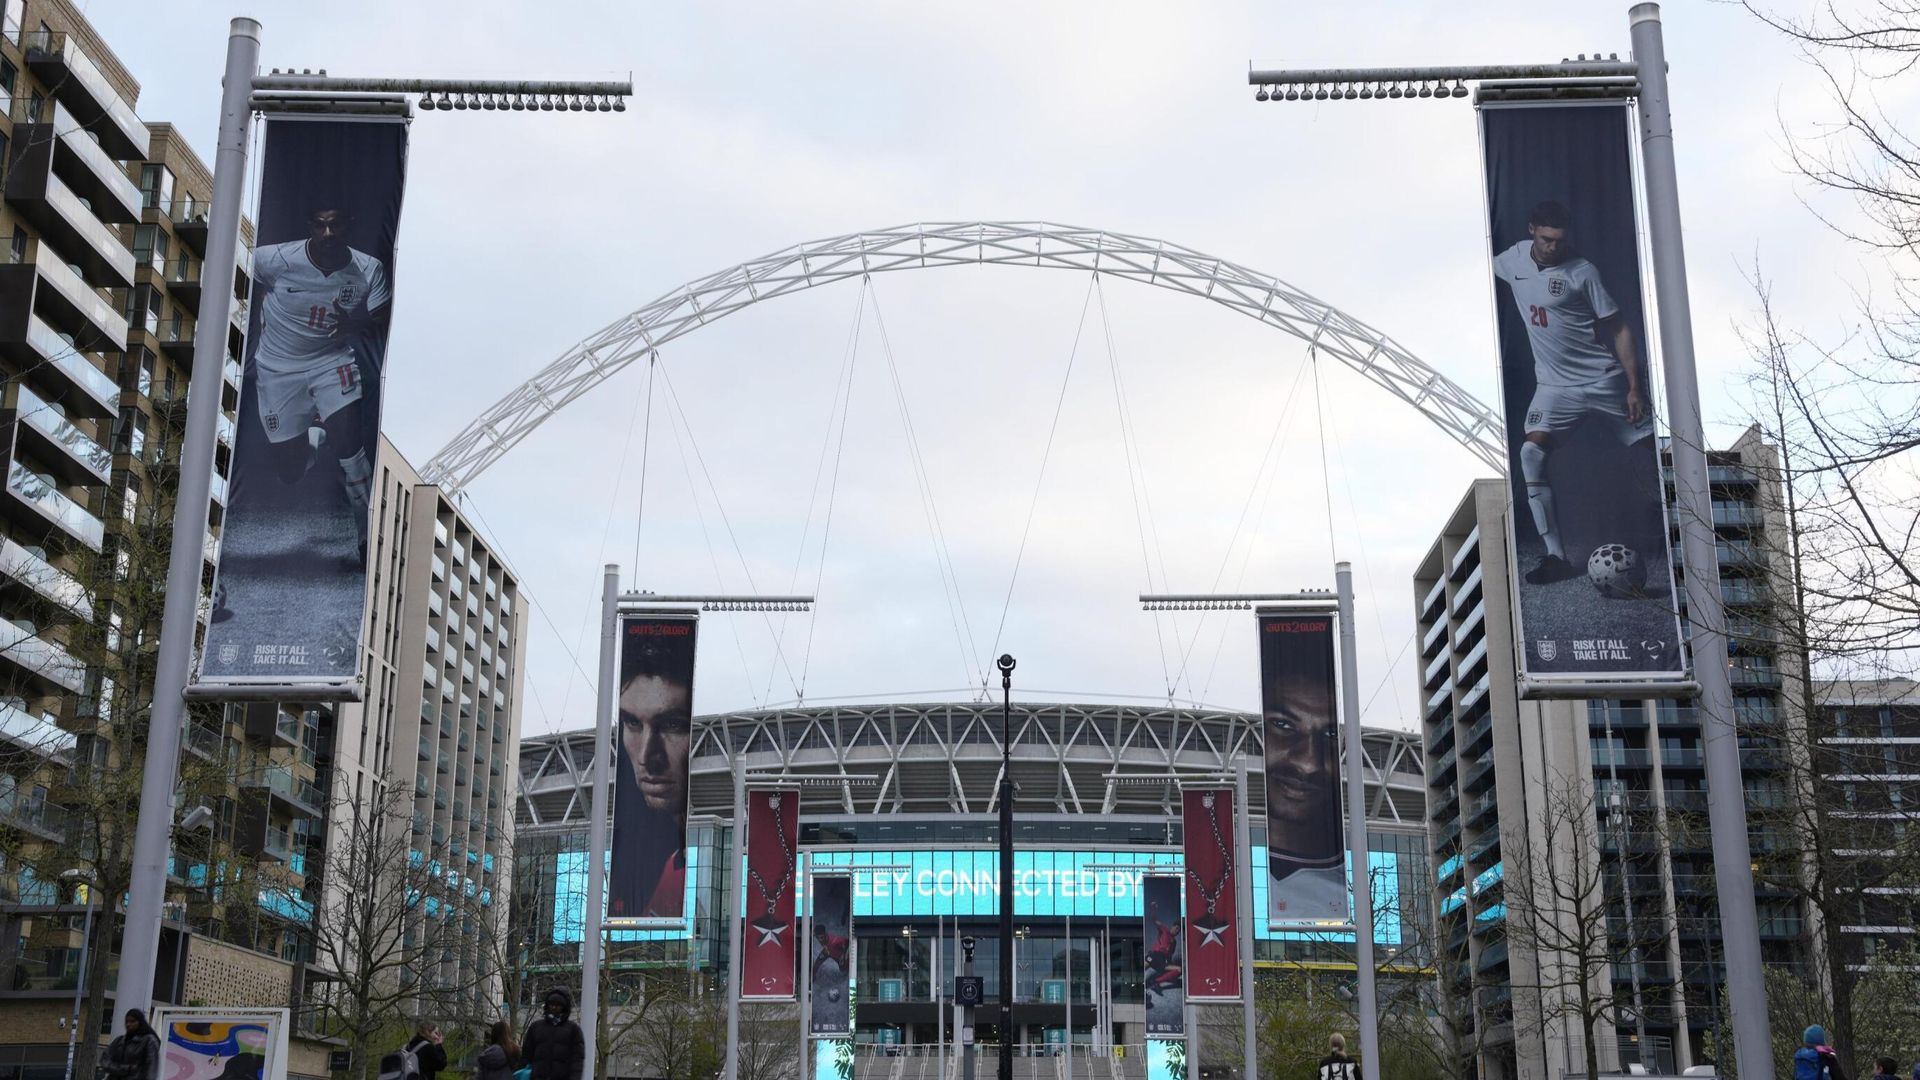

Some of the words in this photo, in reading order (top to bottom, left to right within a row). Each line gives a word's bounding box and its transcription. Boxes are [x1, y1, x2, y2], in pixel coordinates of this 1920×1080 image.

[308, 305, 326, 329] 11
[1530, 304, 1548, 329] 20
[337, 364, 354, 387] 11
[255, 645, 277, 654] RISK
[278, 645, 288, 655] IT
[289, 645, 309, 655] ALL.
[1573, 640, 1595, 650] RISK
[1597, 640, 1606, 650] IT
[1608, 640, 1628, 650] ALL.
[253, 654, 276, 664] TAKE
[278, 655, 288, 664] IT
[289, 655, 309, 665] ALL.
[1573, 650, 1597, 660] TAKE
[1600, 650, 1609, 660] IT
[1610, 650, 1631, 660] ALL.
[916, 869, 1100, 898] CONNECTED
[1106, 870, 1145, 898] BY
